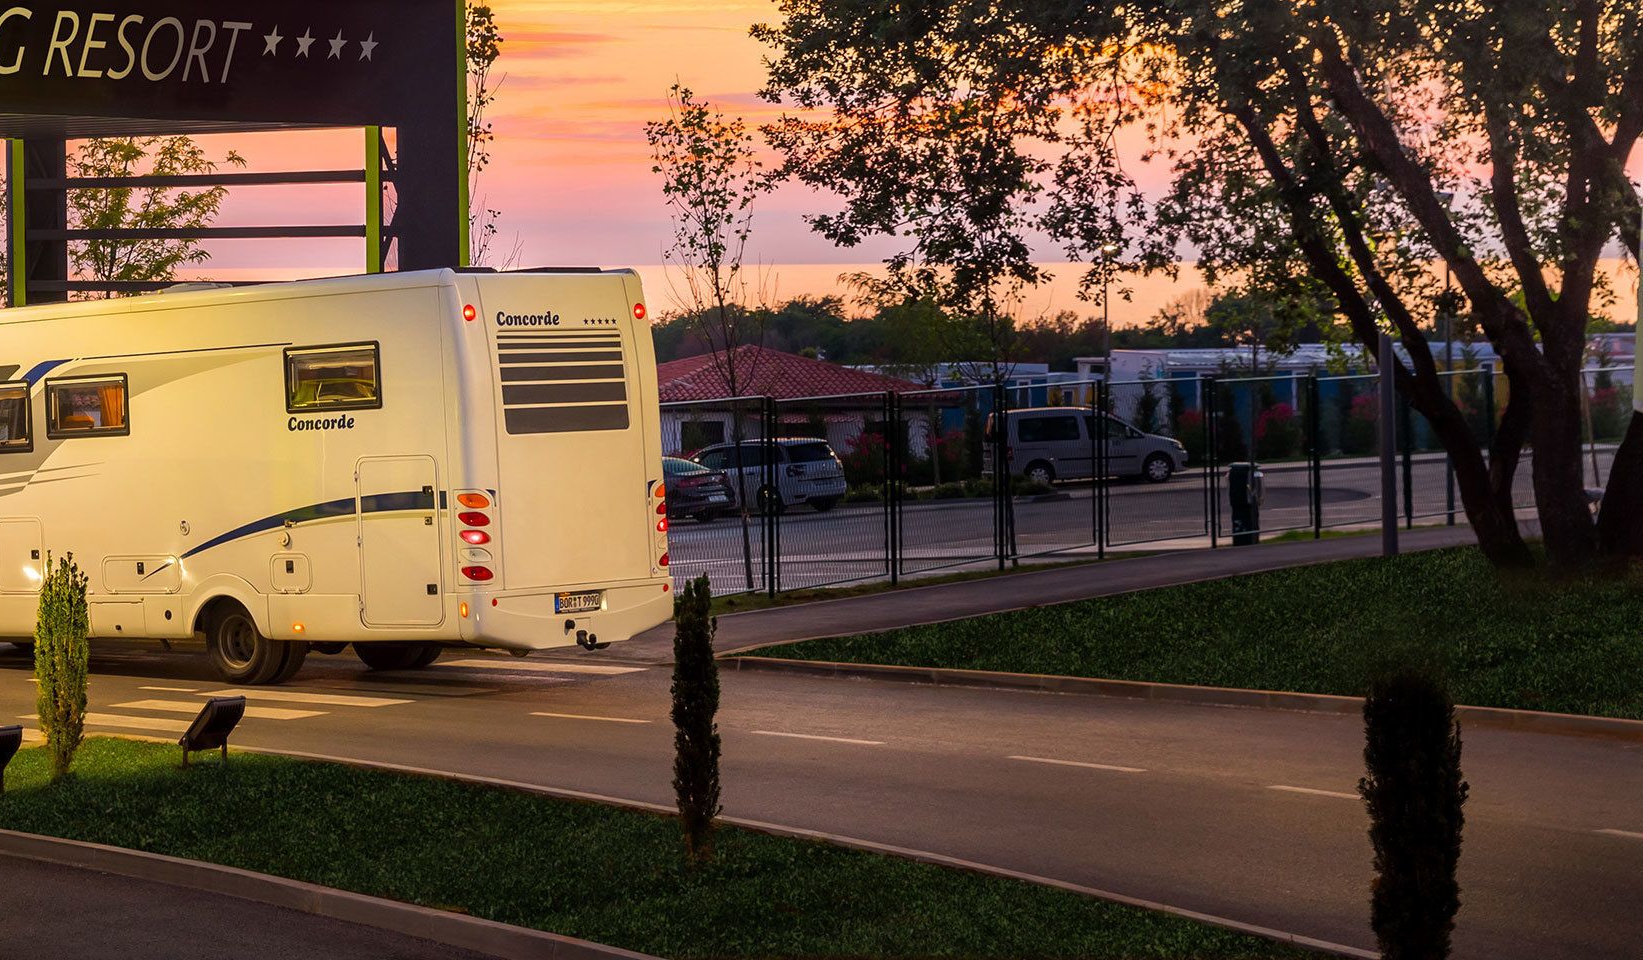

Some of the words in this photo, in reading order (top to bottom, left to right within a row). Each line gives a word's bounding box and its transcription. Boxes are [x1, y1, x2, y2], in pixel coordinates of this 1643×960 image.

[42, 10, 253, 84] RESORT
[495, 310, 561, 327] Concorde
[287, 414, 355, 432] Concorde
